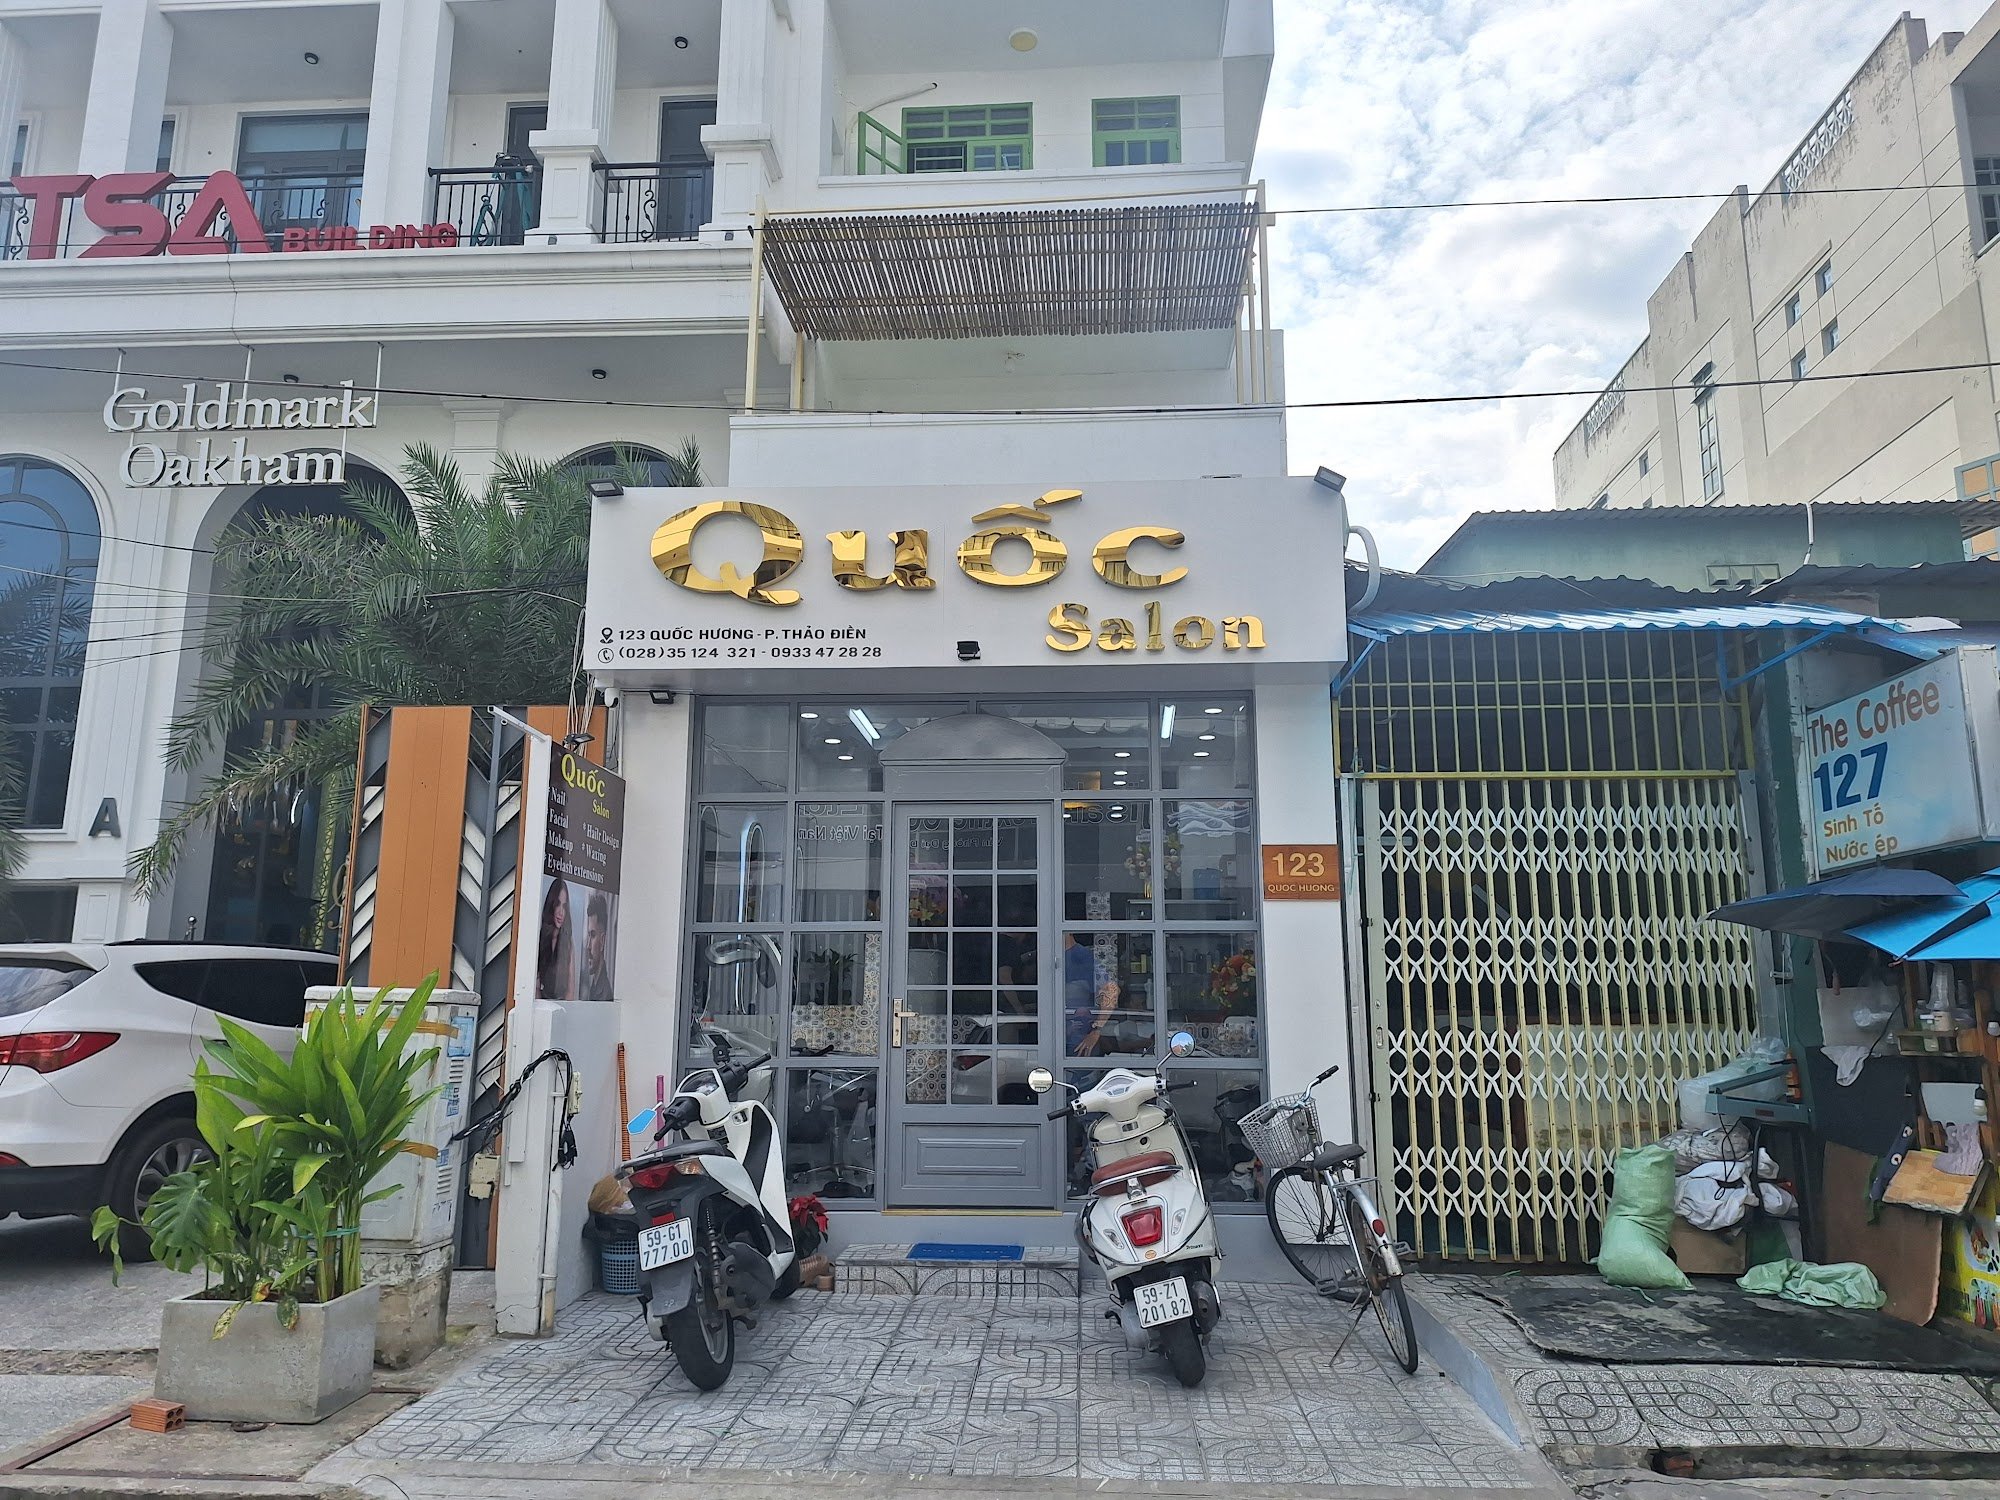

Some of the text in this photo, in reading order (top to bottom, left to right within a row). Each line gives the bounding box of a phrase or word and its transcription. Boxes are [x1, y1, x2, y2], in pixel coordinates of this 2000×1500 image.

[10, 170, 459, 260] TSA BUILDING
[103, 380, 378, 432] Goldmark
[119, 436, 347, 489] Oakham
[650, 489, 1188, 606] Quốc
[618, 629, 645, 640] 123
[650, 626, 693, 640] QUỐC
[699, 628, 754, 640] HƯƠNG
[830, 625, 866, 640] ĐIỀN
[1045, 600, 1267, 652] Salon
[692, 647, 719, 658] 124
[727, 647, 756, 658] 321
[771, 647, 811, 658] 0933
[815, 647, 834, 658] 47
[838, 647, 858, 658] 28
[862, 646, 882, 658] 28
[1808, 681, 1940, 757] The Coffee
[561, 753, 605, 798] Quốc
[1813, 741, 1888, 812] 127
[551, 786, 566, 806] Nail
[592, 799, 610, 819] Salon
[88, 797, 121, 839] A
[549, 808, 569, 829] Facial
[1823, 803, 1885, 837] Sinh Tố
[548, 829, 574, 855] Makeup
[602, 830, 620, 851] Design
[1826, 834, 1898, 864] Nước ép
[586, 843, 607, 867] Waxing
[1272, 853, 1325, 877] 123
[547, 853, 605, 884] Eyelash extensions
[1268, 884, 1335, 893] QUOC HUONG
[646, 1223, 681, 1248] 59-G1
[644, 1240, 689, 1267] 777.00
[1142, 1282, 1178, 1304] 59-Z1
[1142, 1298, 1189, 1324] 201.82
